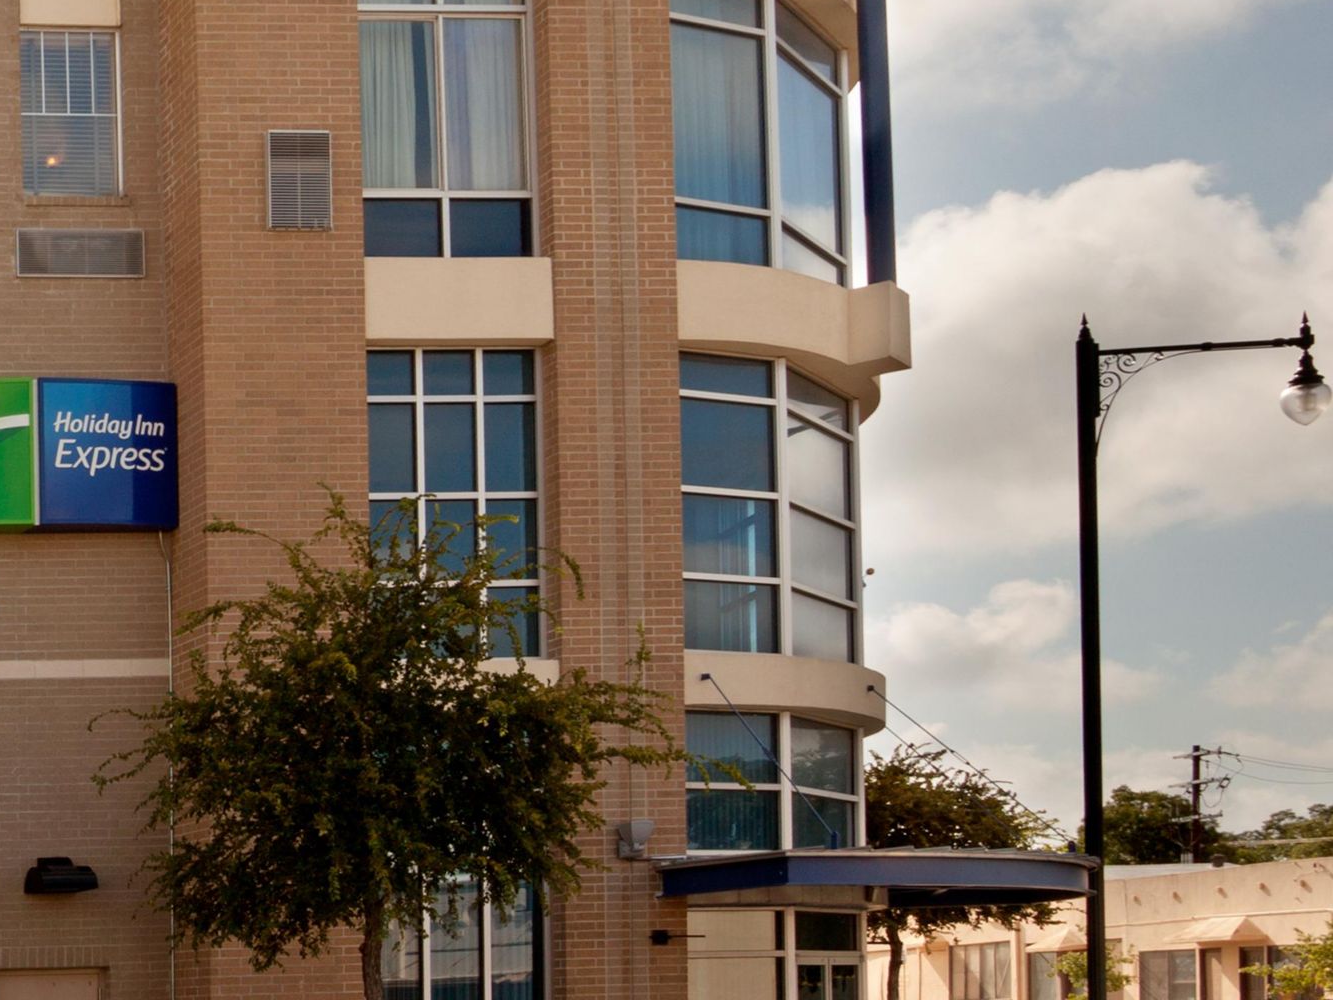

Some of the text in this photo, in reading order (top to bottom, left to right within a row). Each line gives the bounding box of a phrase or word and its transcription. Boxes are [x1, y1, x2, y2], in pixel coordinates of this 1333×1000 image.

[53, 411, 165, 440] Holiday Inn
[54, 438, 166, 478] Express
